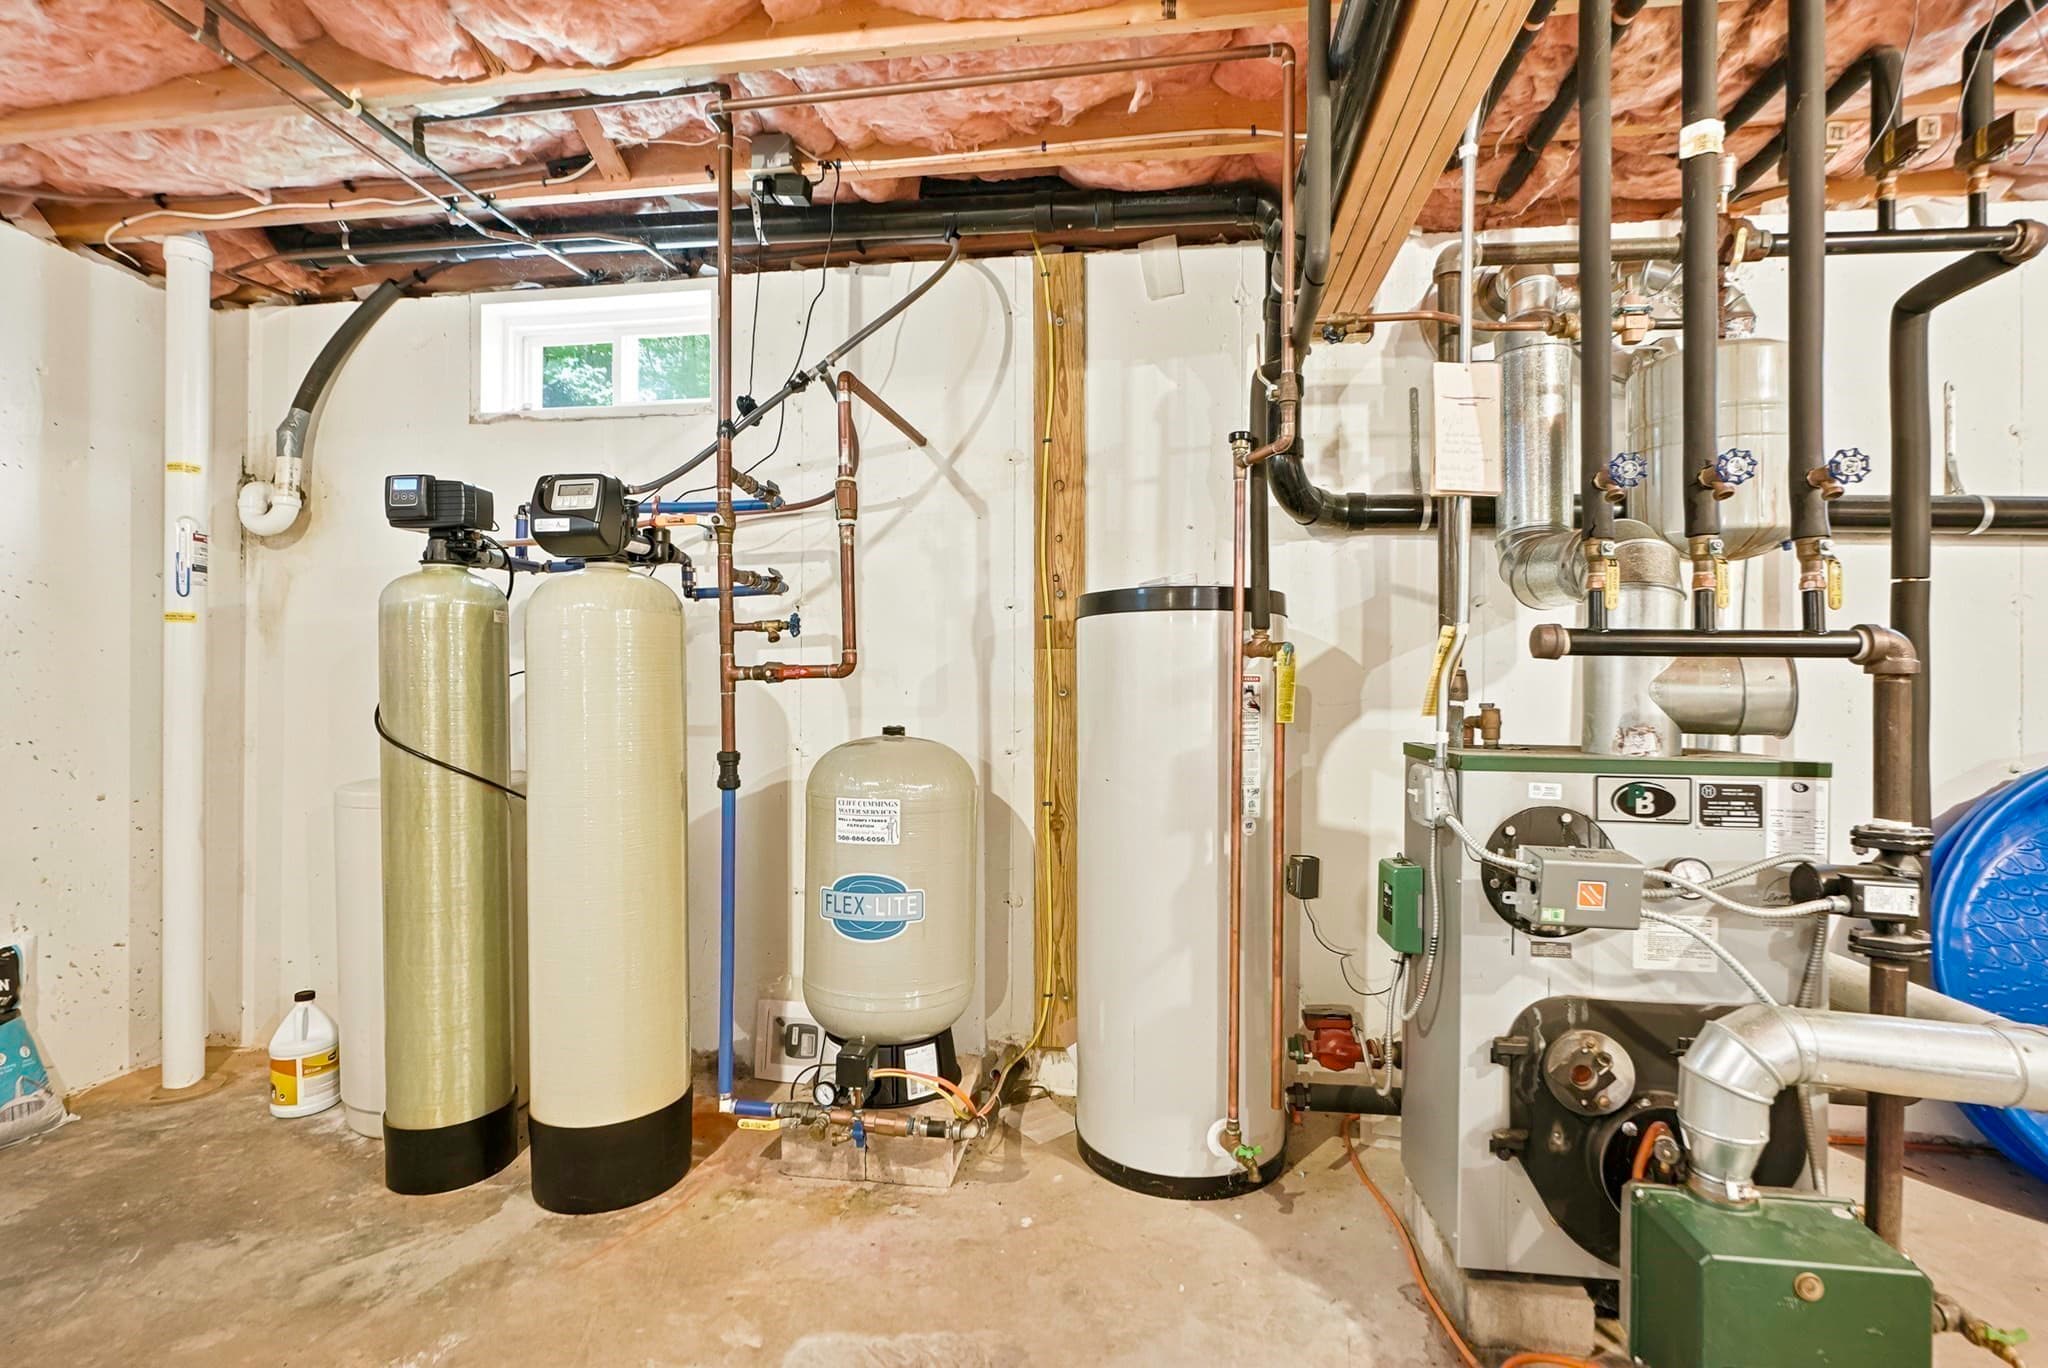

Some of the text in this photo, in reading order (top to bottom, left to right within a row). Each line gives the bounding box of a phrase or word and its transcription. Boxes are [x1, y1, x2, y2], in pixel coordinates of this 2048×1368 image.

[857, 800, 899, 808] CUMMINGS
[1627, 784, 1656, 815] PB
[825, 893, 918, 917] FLEX-LITE
